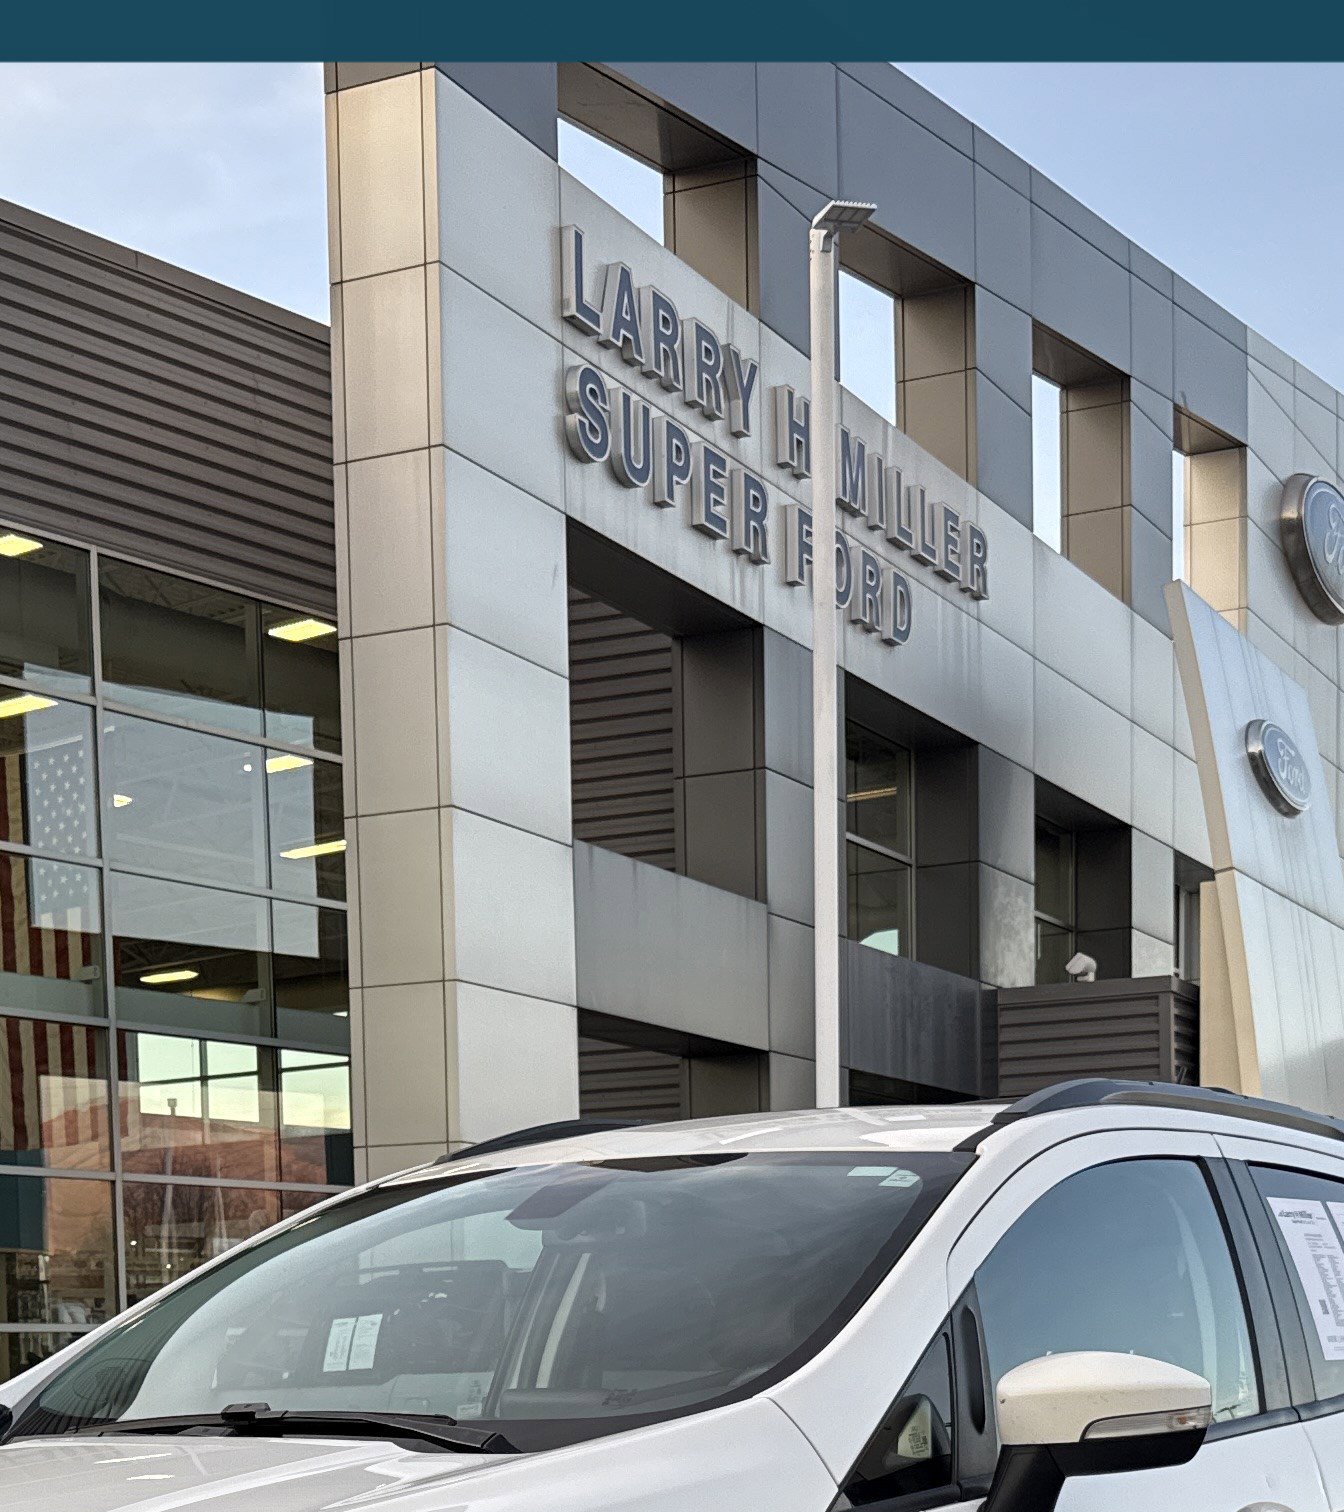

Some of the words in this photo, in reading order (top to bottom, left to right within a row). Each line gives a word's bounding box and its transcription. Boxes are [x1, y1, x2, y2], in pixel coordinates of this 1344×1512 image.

[562, 224, 759, 437] LARRY
[775, 384, 812, 480] H
[836, 423, 990, 600] MILLER
[566, 364, 770, 566] SUPER
[786, 502, 913, 647] FORD
